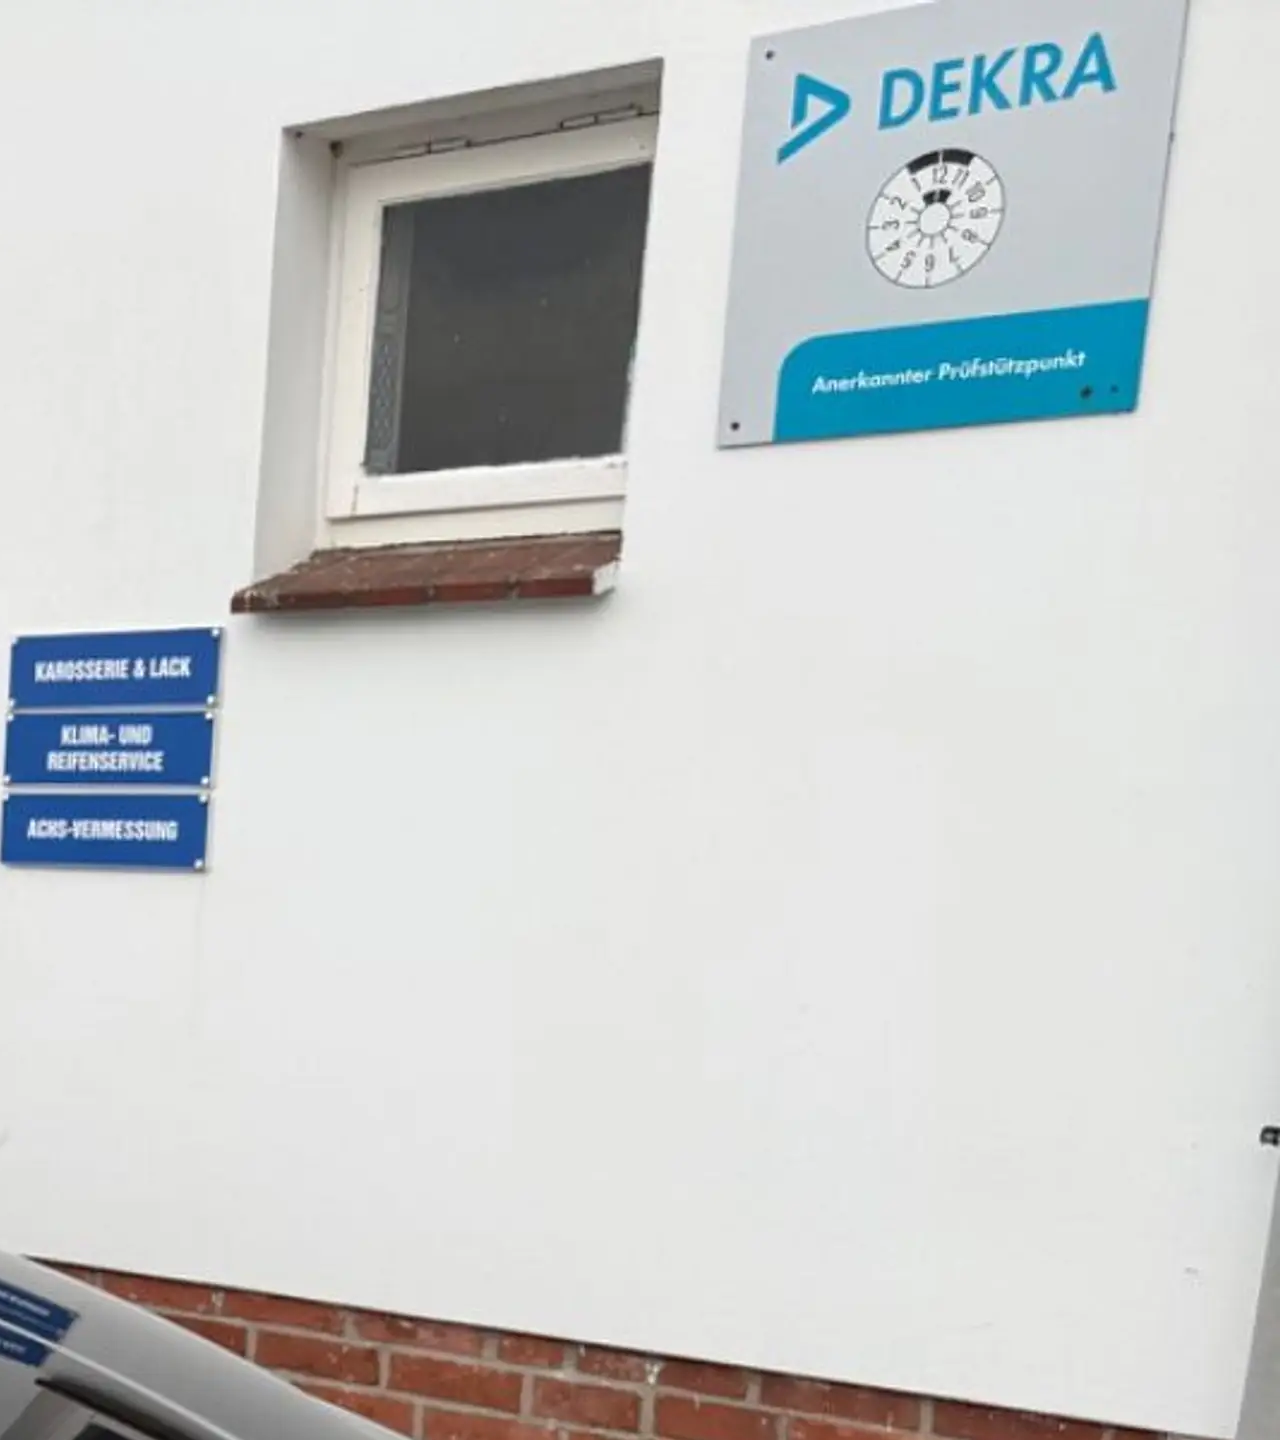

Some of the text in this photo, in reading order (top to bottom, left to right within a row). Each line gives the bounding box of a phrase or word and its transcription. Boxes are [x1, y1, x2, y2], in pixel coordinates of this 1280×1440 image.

[877, 31, 1118, 131] DEKRA
[811, 347, 1087, 394] Anerkannter Prüfstützpunkt
[34, 656, 192, 683] KAROSSERIE & LACK
[60, 724, 154, 745] KLIMA- UND
[46, 750, 165, 772] REIFENSERVICE
[27, 819, 179, 842] ACHS-VERMESSUNG
